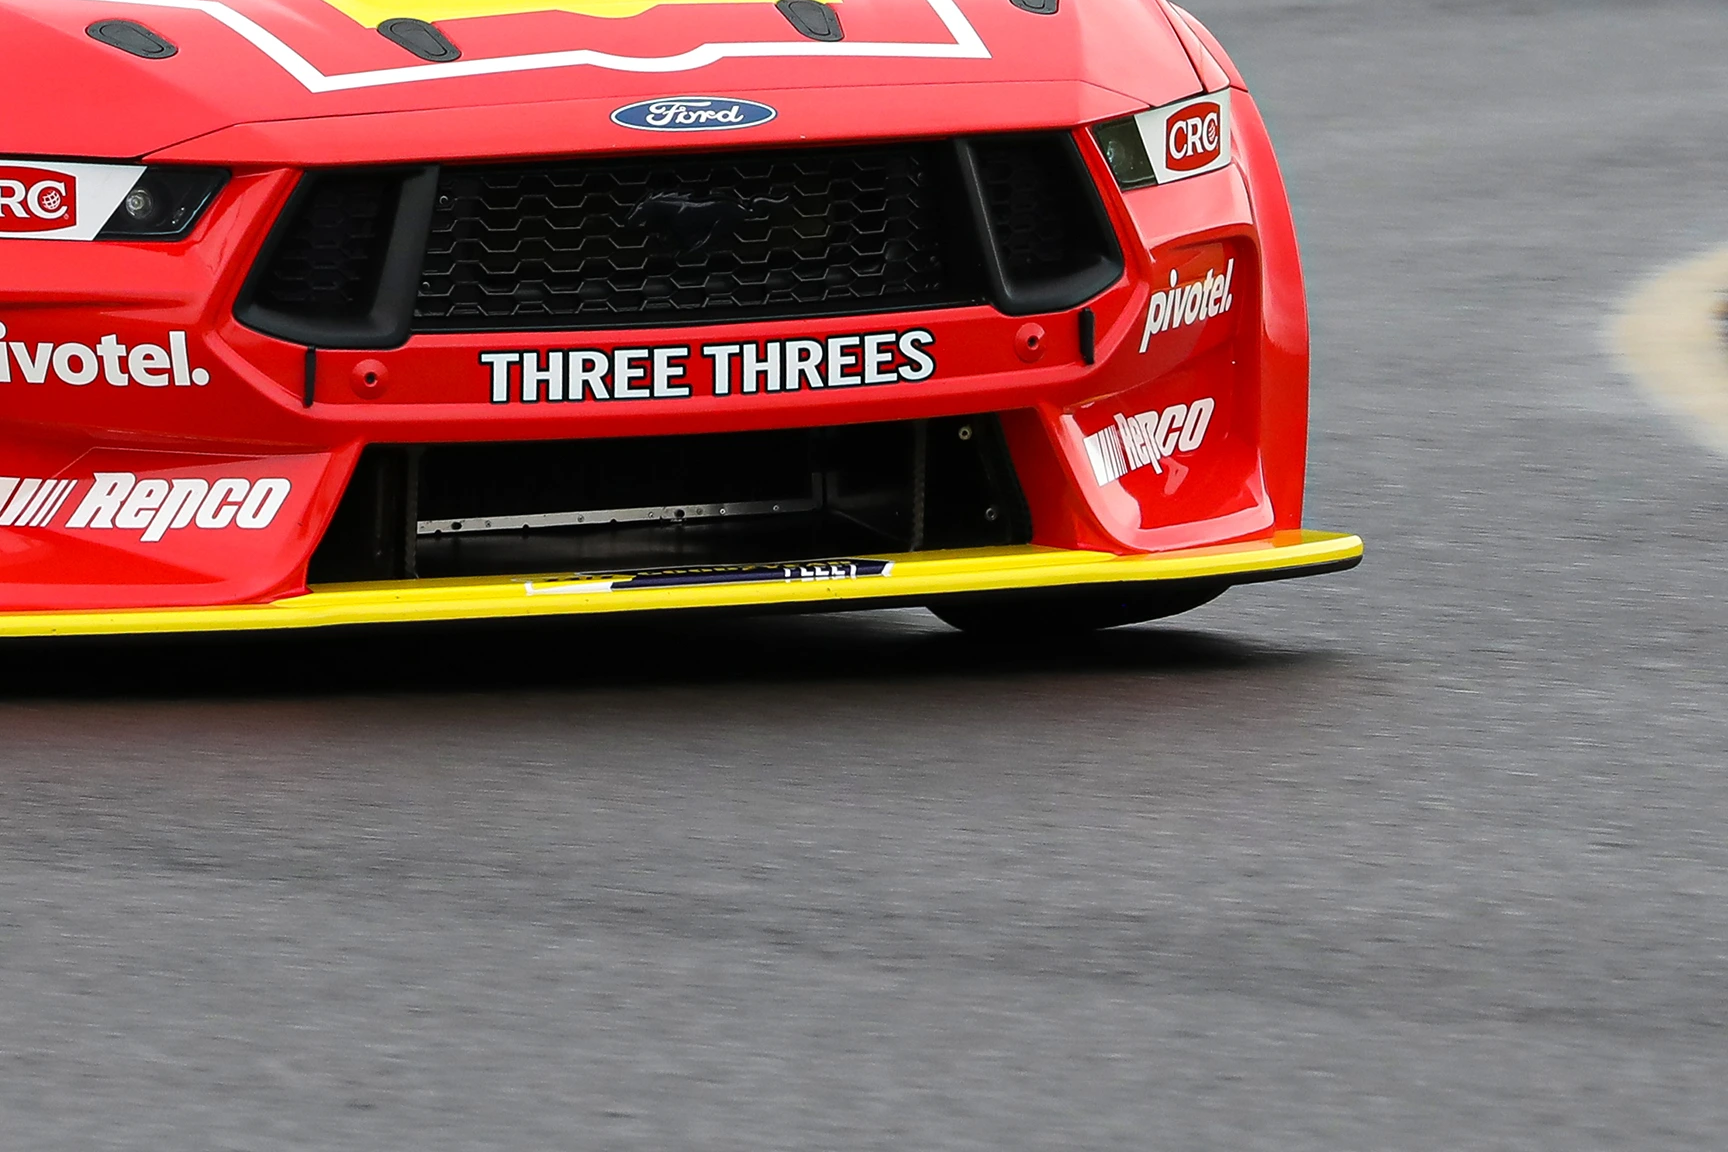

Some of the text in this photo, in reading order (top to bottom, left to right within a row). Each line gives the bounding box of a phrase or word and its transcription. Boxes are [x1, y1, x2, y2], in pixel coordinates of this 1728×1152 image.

[645, 101, 745, 126] Ford
[1169, 111, 1220, 160] CRC
[1139, 258, 1235, 354] pivotel.
[479, 329, 936, 403] THREE THREES
[1115, 396, 1216, 475] Repco
[68, 471, 292, 542] Repco
